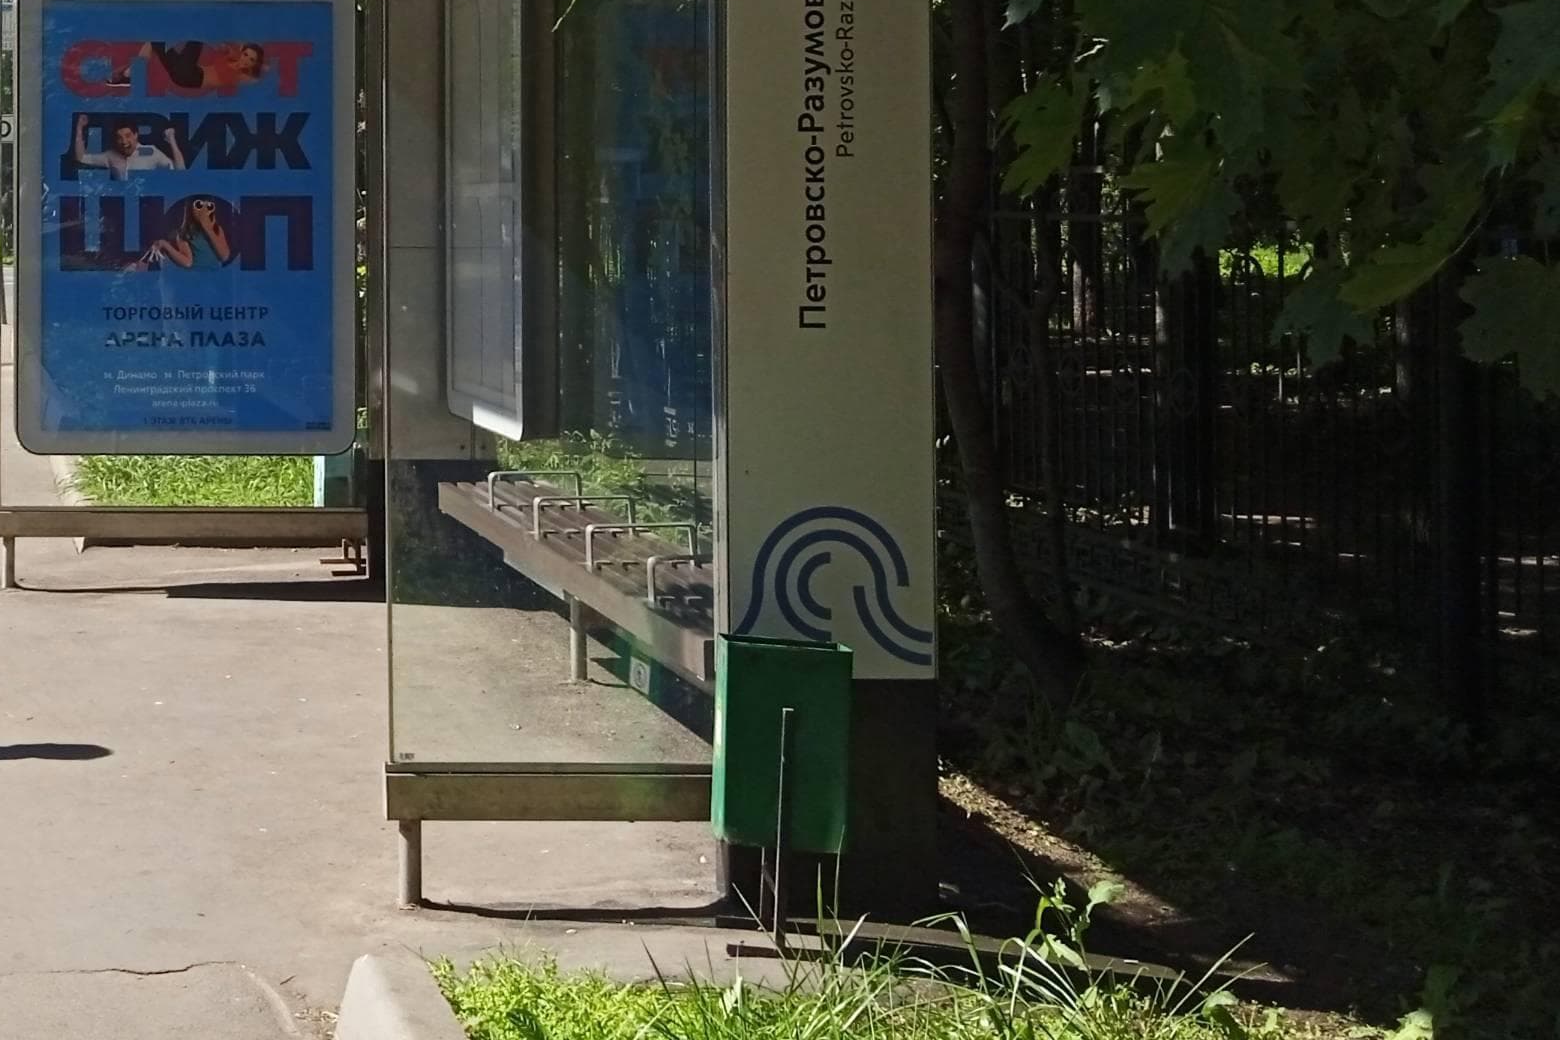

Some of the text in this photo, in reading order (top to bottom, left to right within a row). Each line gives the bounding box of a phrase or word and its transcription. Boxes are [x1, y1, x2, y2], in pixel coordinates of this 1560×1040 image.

[61, 194, 313, 271] ШОП
[103, 304, 269, 322] ТОРГОВЫЙ ЦЕНТР
[104, 331, 266, 348] АРЕНА ПЛАЗА
[116, 370, 158, 380] Динамо
[177, 370, 239, 380] Петроский
[240, 371, 265, 381] парк
[113, 384, 192, 396] Ленинградский
[244, 384, 256, 393] 36
